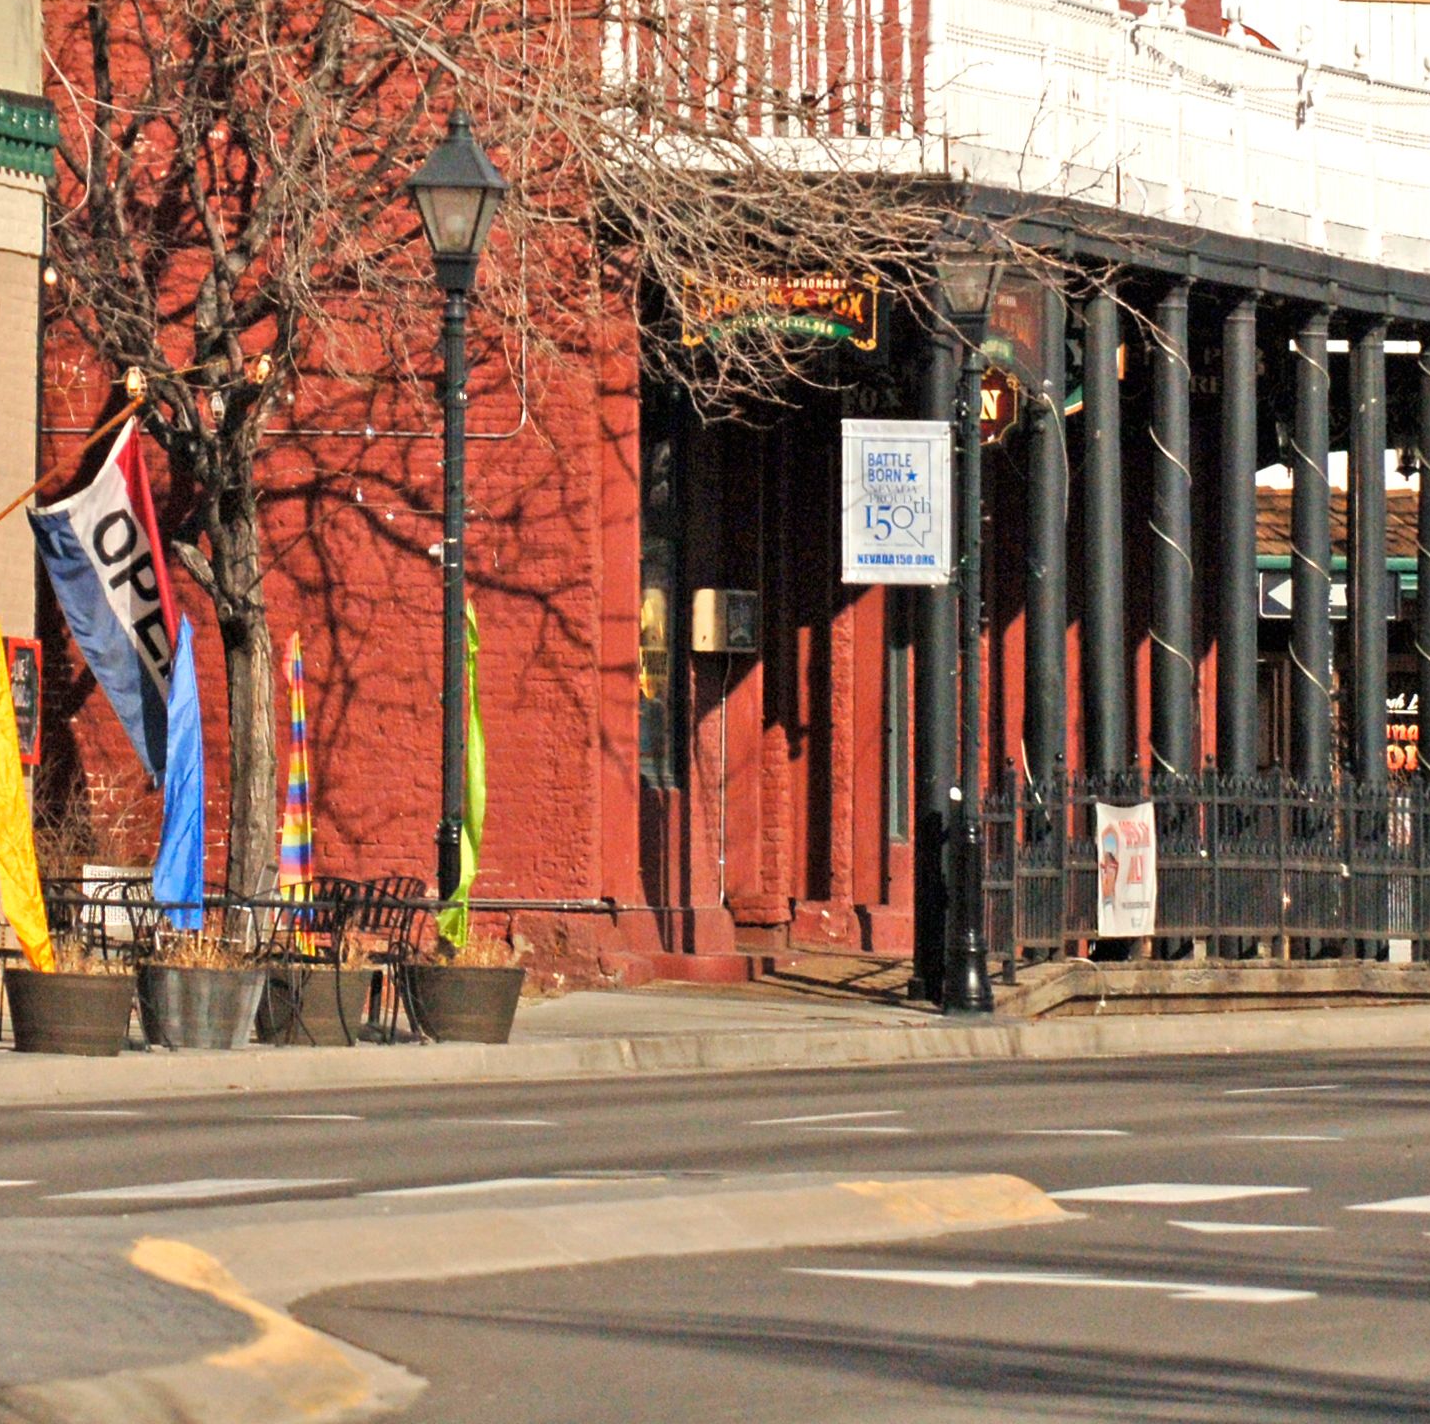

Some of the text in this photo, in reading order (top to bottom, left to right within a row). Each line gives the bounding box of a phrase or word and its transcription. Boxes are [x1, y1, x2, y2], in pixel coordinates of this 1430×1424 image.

[867, 452, 913, 468] BATTLE
[867, 467, 902, 483] BORN
[92, 508, 173, 681] OPE
